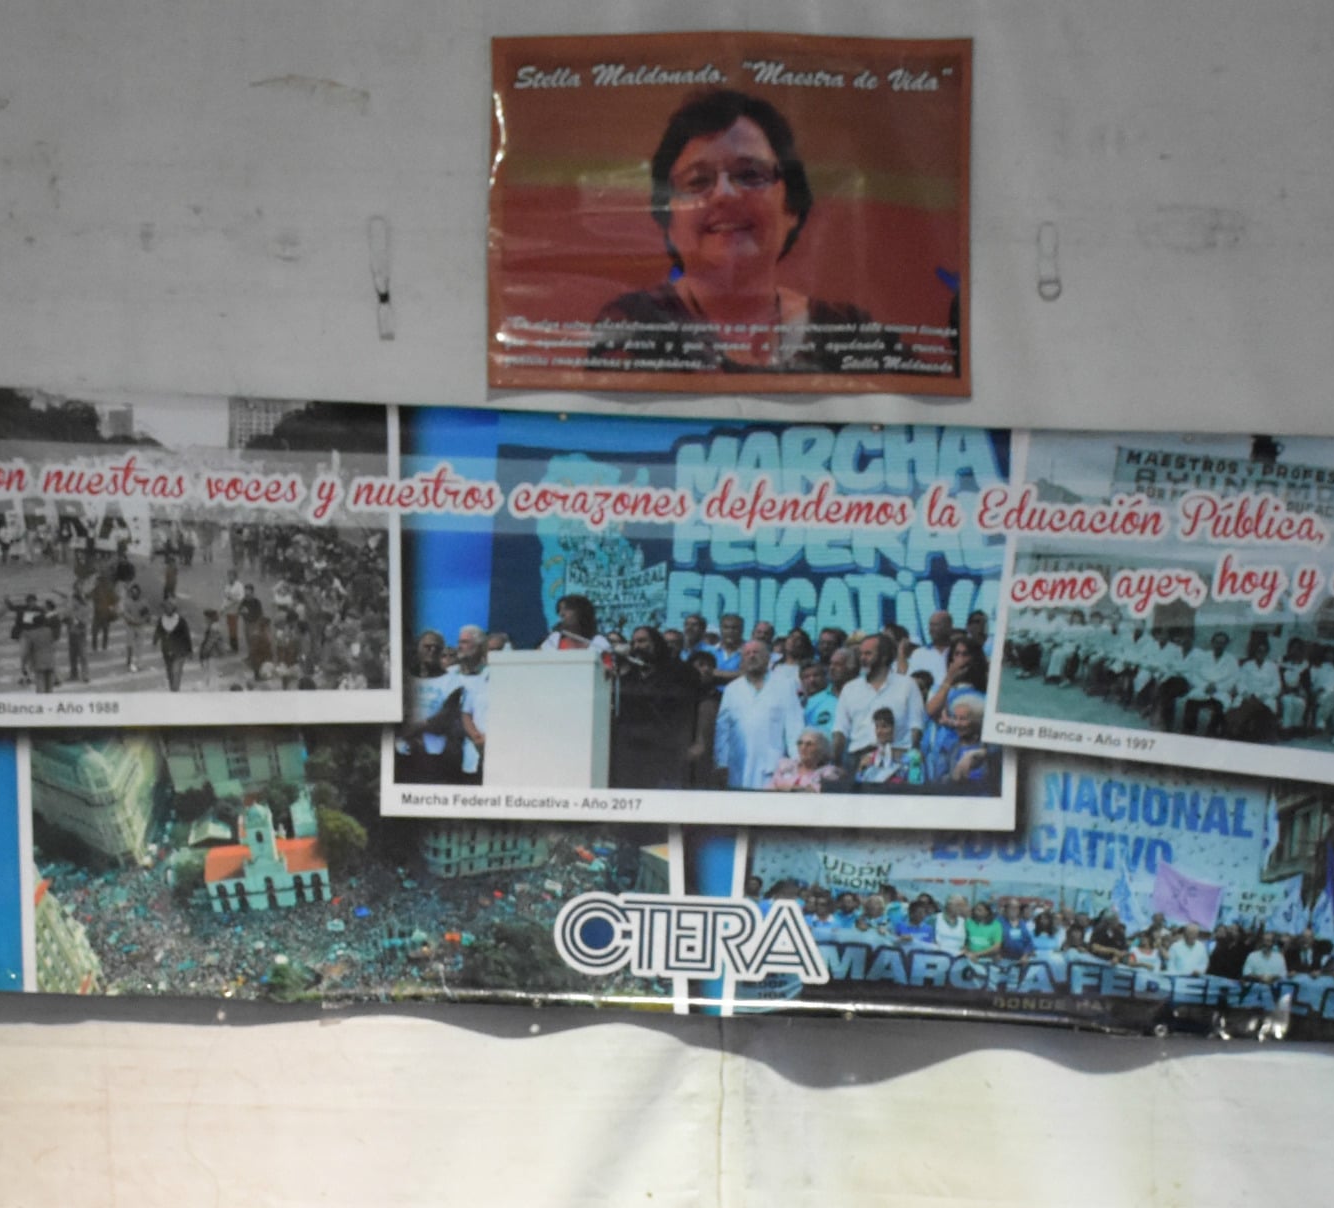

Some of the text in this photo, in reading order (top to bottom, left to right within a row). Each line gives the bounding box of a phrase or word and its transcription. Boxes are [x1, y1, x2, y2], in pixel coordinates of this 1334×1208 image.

[514, 65, 580, 90] Stella
[853, 68, 878, 89] de
[1126, 450, 1237, 474] MAESTROS
[42, 455, 184, 499] nuestras
[205, 474, 299, 503] voces
[312, 482, 337, 519] y
[354, 466, 496, 511] nuestros
[513, 484, 690, 526] corazones
[706, 477, 911, 530] defendemos
[927, 486, 961, 528] la
[978, 487, 1163, 537] Educación
[1181, 495, 1326, 544] Pública,
[1011, 572, 1099, 602] como
[1116, 571, 1204, 612] ayer,
[1217, 553, 1282, 610] hoy
[1296, 573, 1318, 607] y
[56, 700, 83, 714] Año
[88, 702, 119, 714] 1988
[995, 723, 1034, 741] Carpa
[1037, 726, 1083, 743] Blanca
[1094, 732, 1121, 748] Año
[1125, 737, 1156, 751] 1997
[401, 794, 449, 808] Marcha
[452, 794, 501, 809] Federal
[504, 795, 570, 810] Educativa
[582, 796, 609, 810] Año
[611, 798, 642, 811] 2017
[1043, 771, 1254, 839] NACIONAL
[555, 892, 829, 985] CTERA
[819, 945, 1055, 994] MARCHA
[1070, 963, 1309, 1014] FEDERAL
